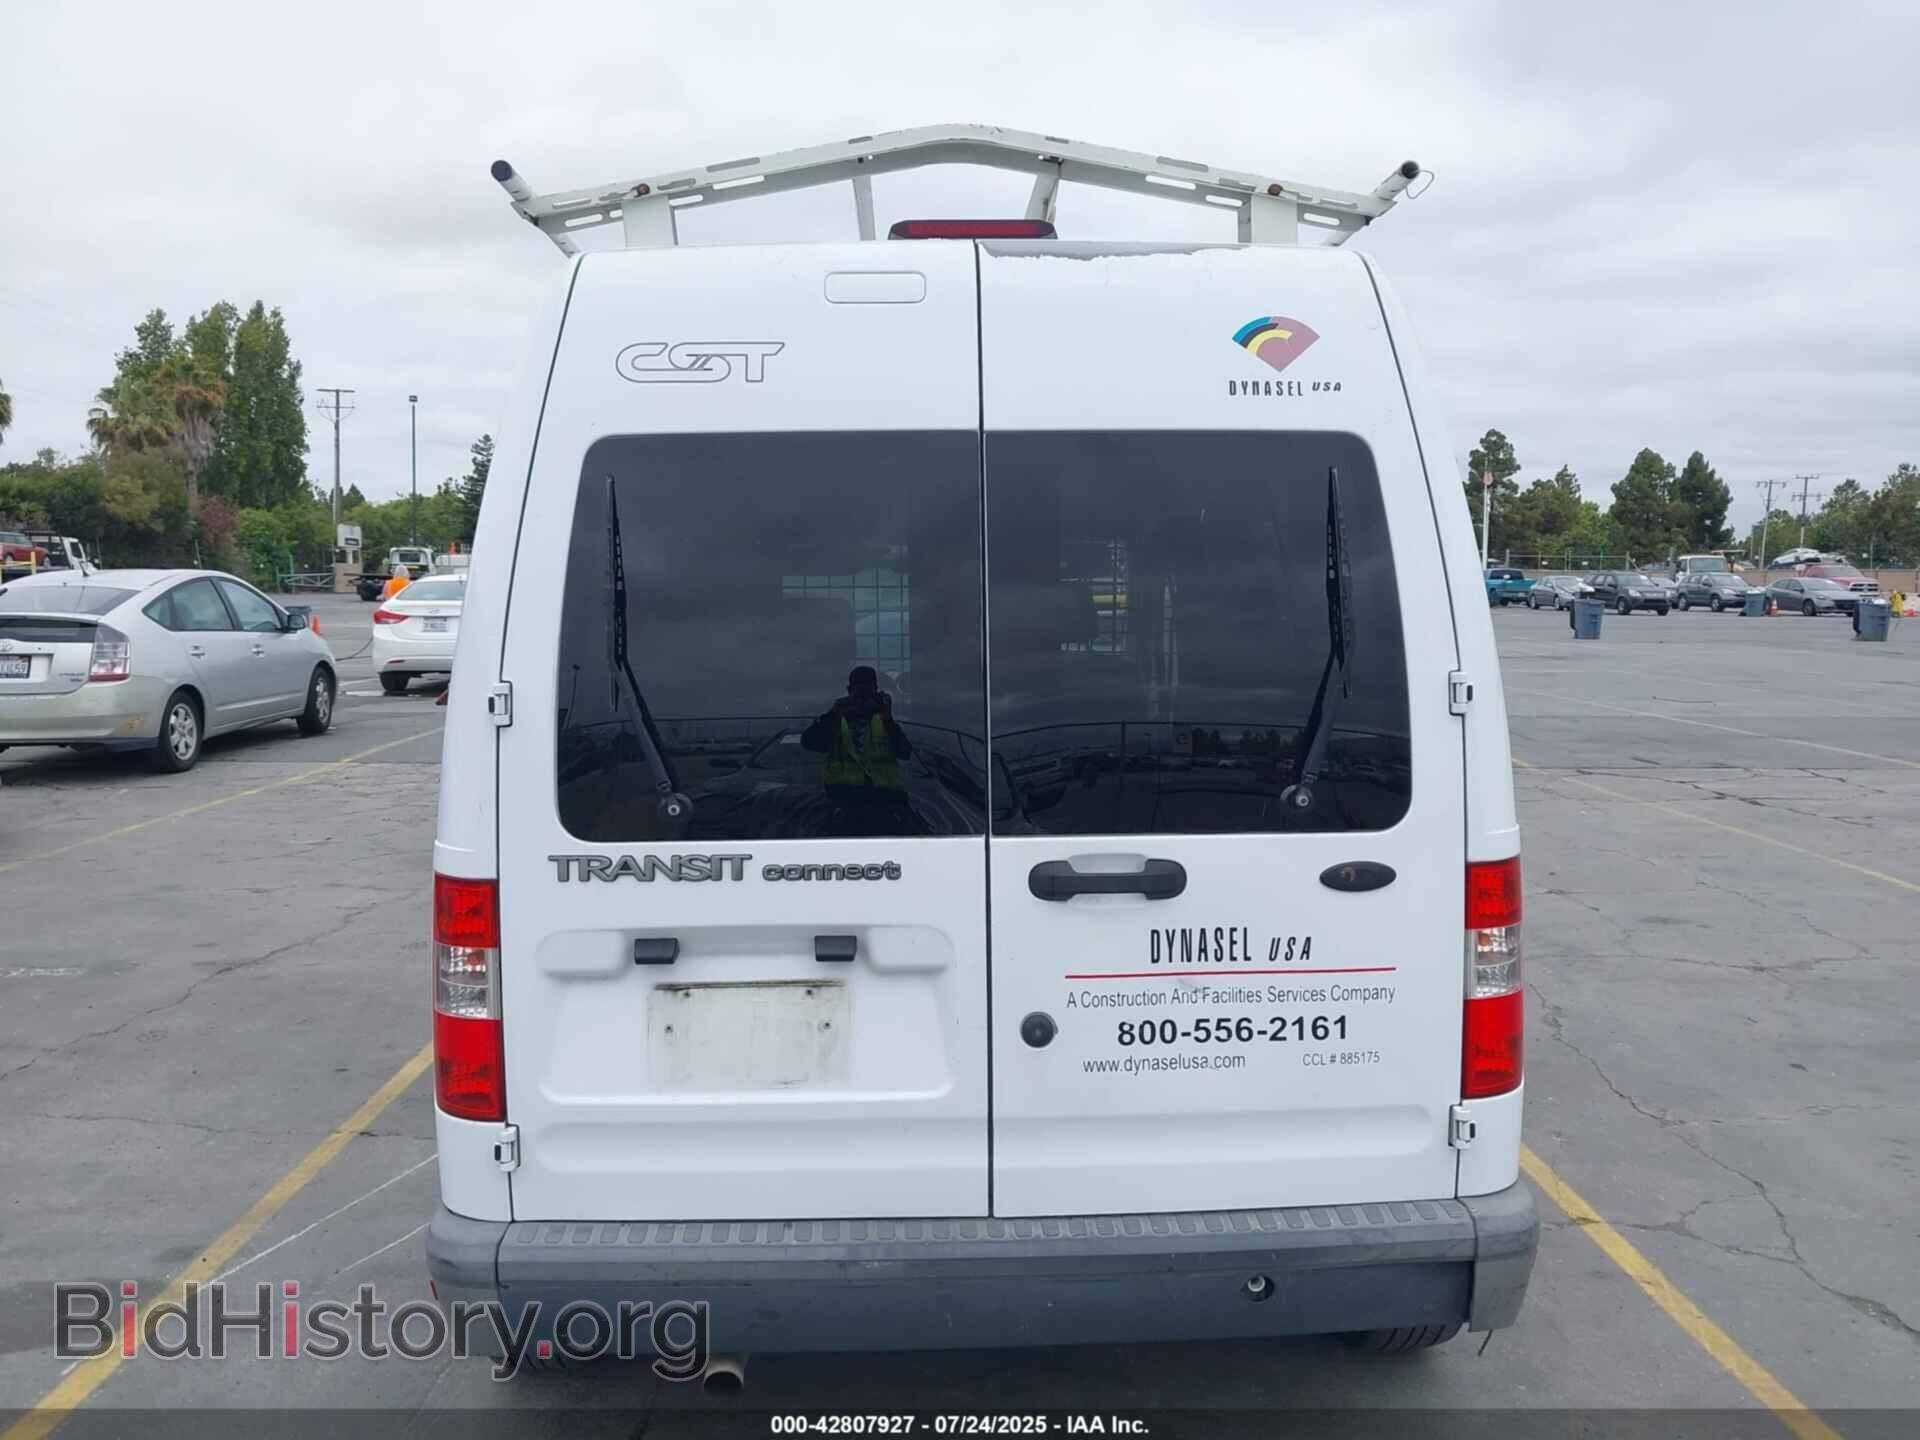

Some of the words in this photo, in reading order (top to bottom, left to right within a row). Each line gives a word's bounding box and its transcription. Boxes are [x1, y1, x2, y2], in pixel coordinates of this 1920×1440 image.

[1229, 381, 1302, 396] DYNASEL
[1312, 382, 1341, 391] USA
[549, 855, 752, 882] TRANSIT
[762, 861, 901, 881] connect
[1151, 927, 1251, 963] DYNASEL
[1269, 937, 1311, 961] USA
[1067, 992, 1077, 1007] A
[1081, 991, 1166, 1008] Construction
[1171, 988, 1200, 1003] And
[1202, 987, 1262, 1003] Facilities
[1267, 986, 1326, 1002] Services
[1331, 985, 1395, 1003] Company
[1118, 1015, 1345, 1046] 800-556-2161
[1083, 1054, 1245, 1076] www.dynaselusa.com
[1303, 1053, 1326, 1066] CCL
[1329, 1052, 1337, 1064] #
